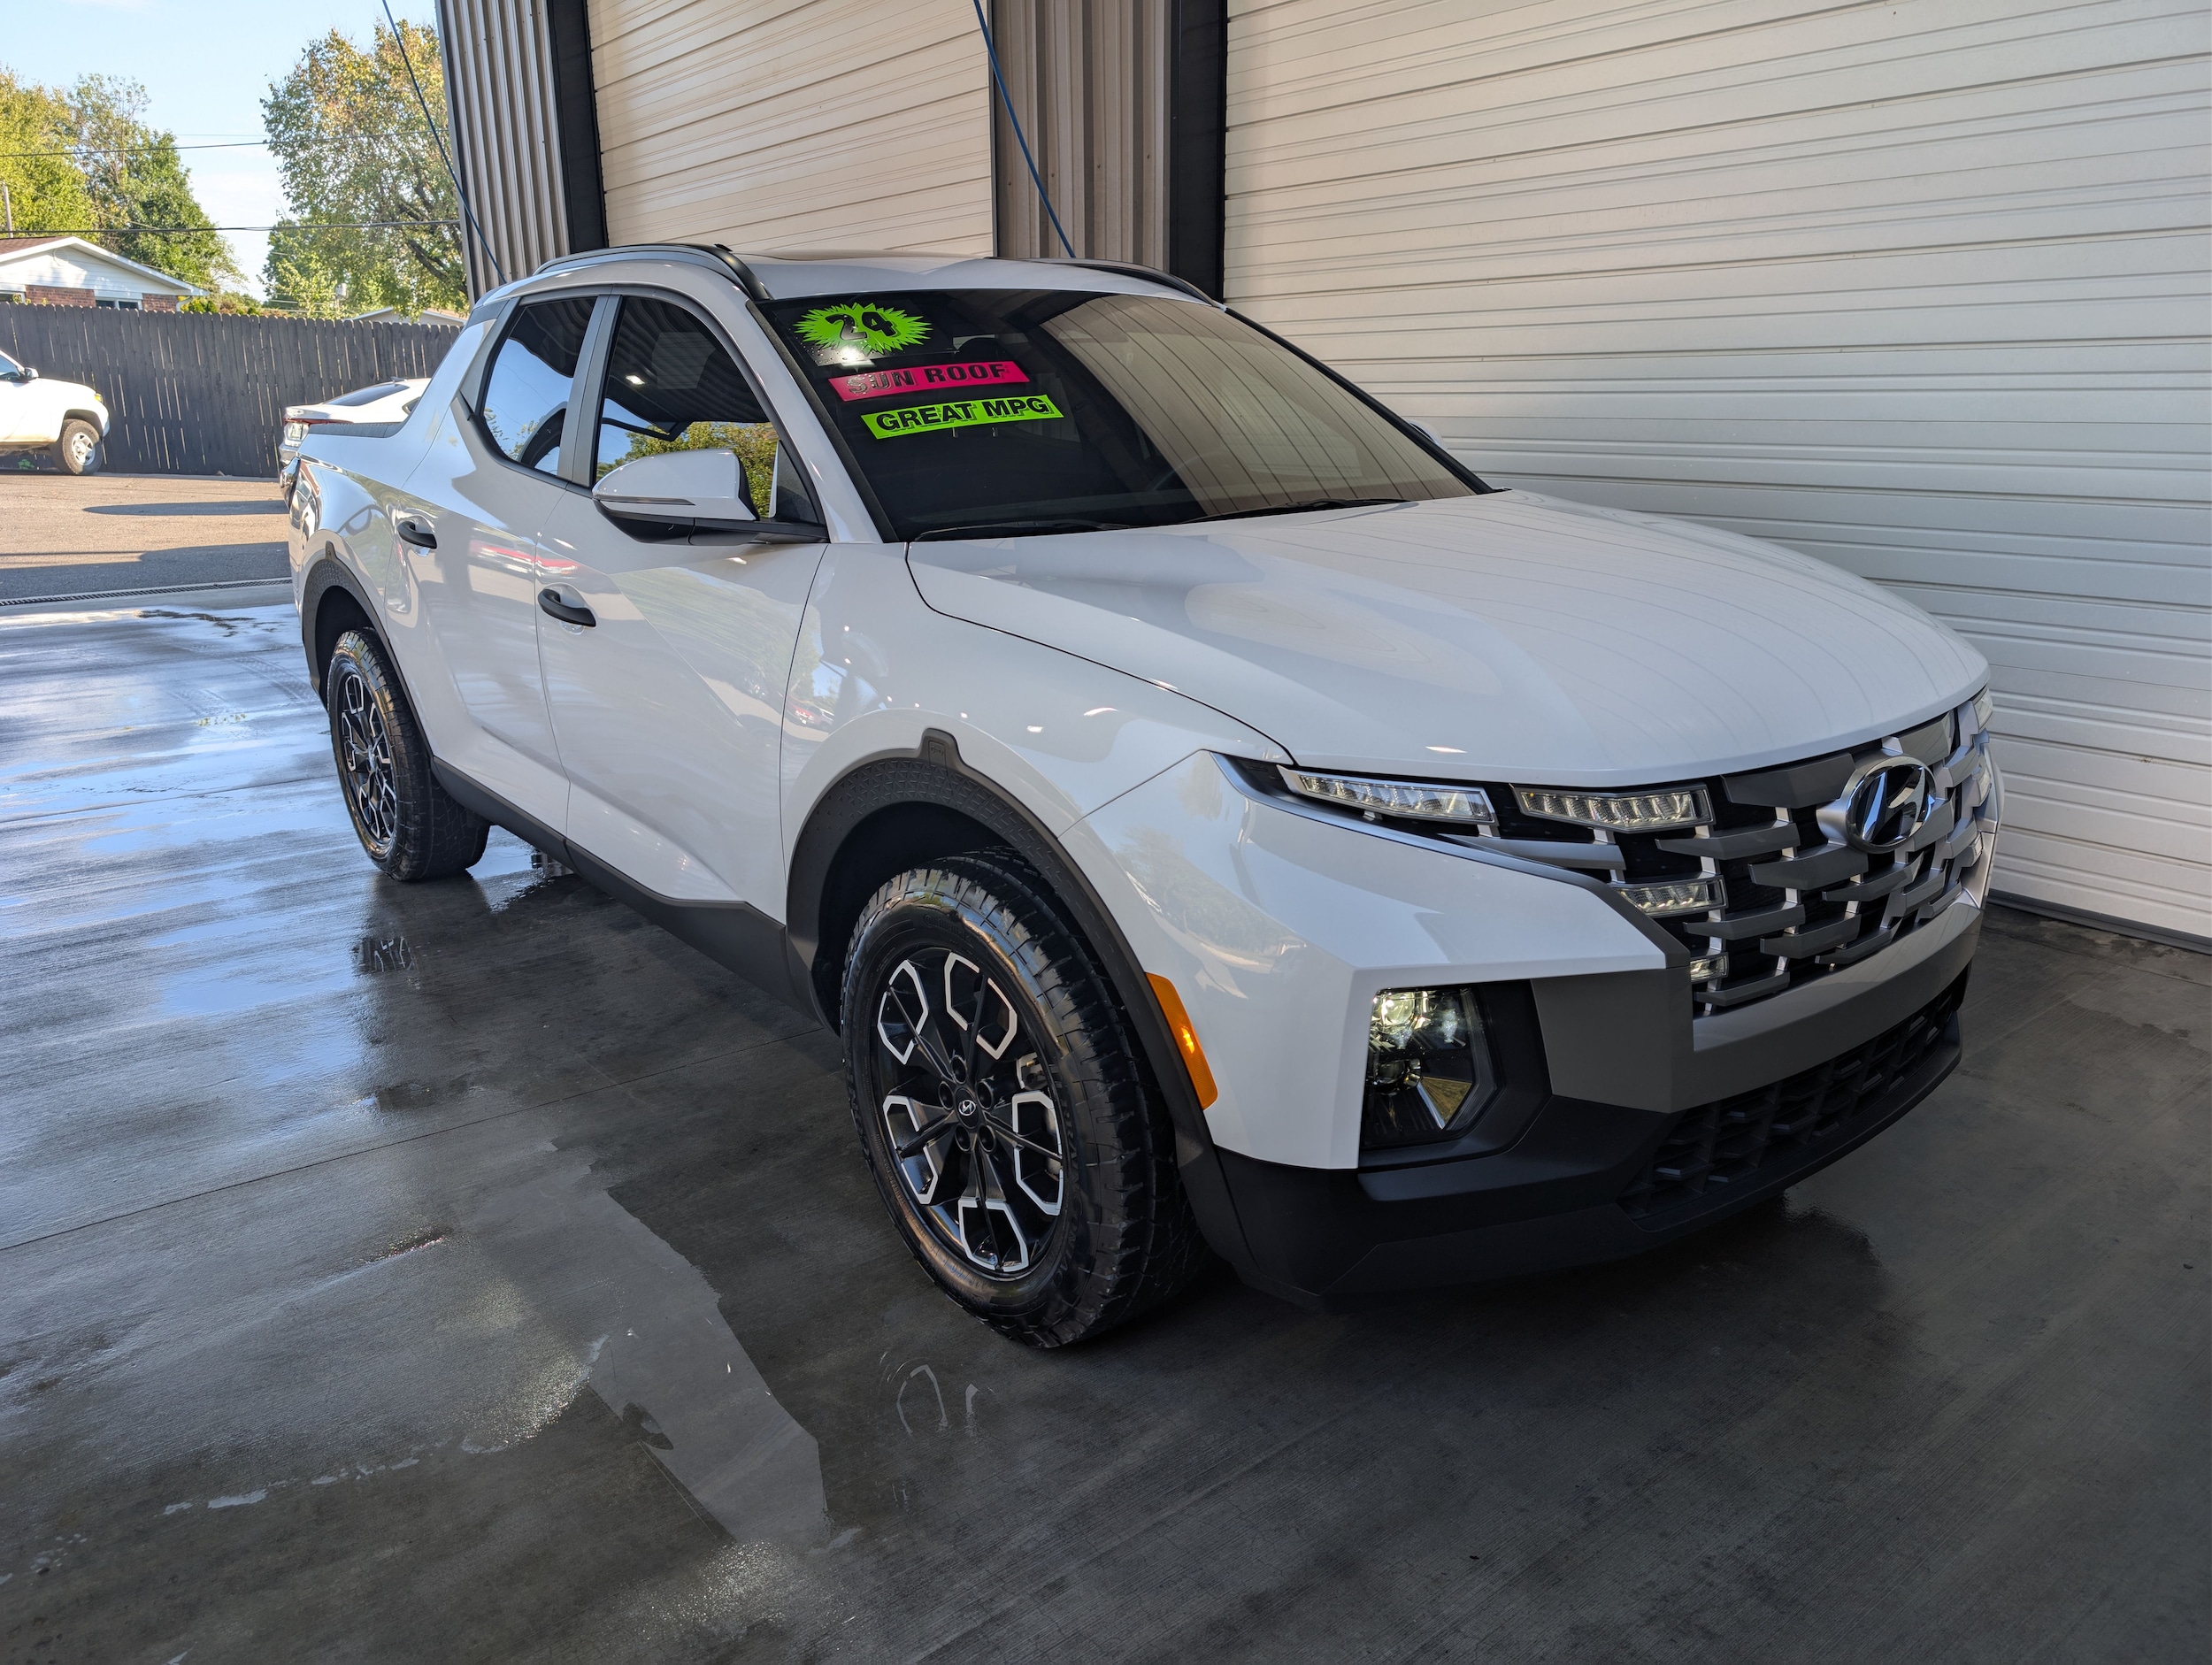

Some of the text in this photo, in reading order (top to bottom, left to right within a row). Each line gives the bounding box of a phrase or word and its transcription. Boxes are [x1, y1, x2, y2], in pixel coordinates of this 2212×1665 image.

[825, 311, 897, 341] 24
[847, 364, 1009, 394] SUN ROOF
[876, 397, 1051, 432] GREAT MPG
